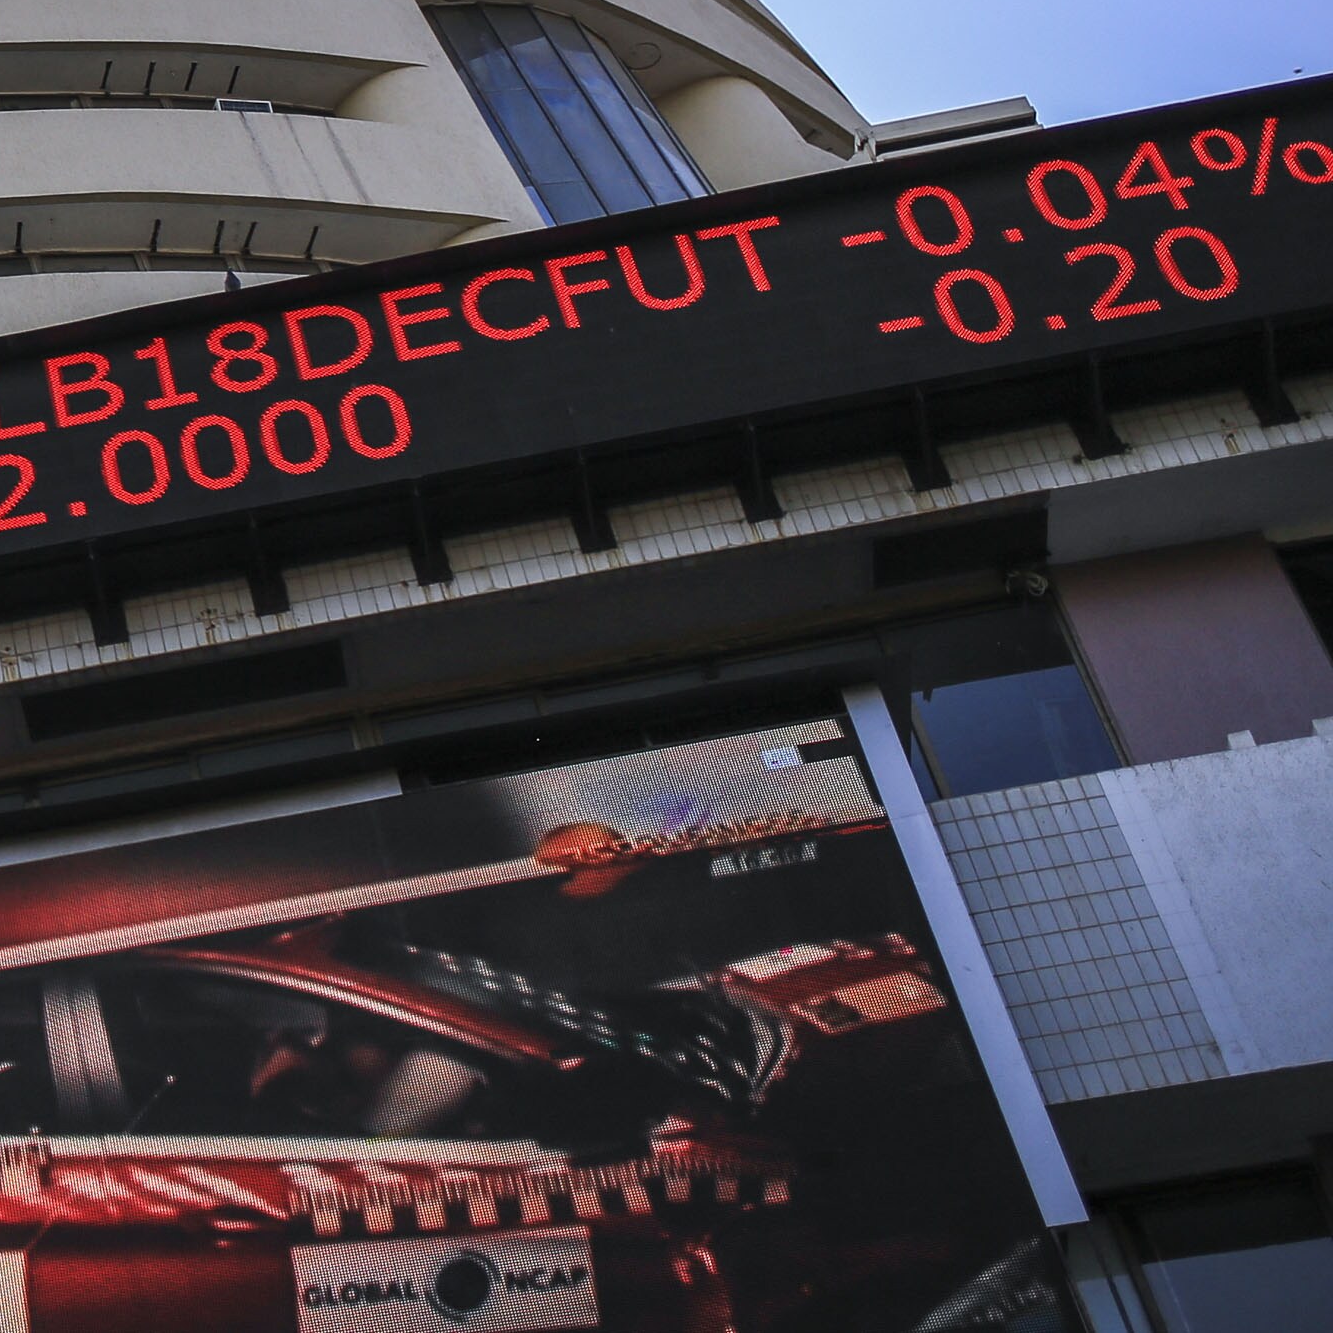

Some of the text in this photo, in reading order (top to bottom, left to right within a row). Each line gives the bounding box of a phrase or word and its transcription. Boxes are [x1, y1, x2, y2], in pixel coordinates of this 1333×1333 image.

[840, 117, 1333, 257] -0.04%
[878, 225, 1241, 344] -0.20
[303, 1266, 589, 1308] GLOBAL NCAP
